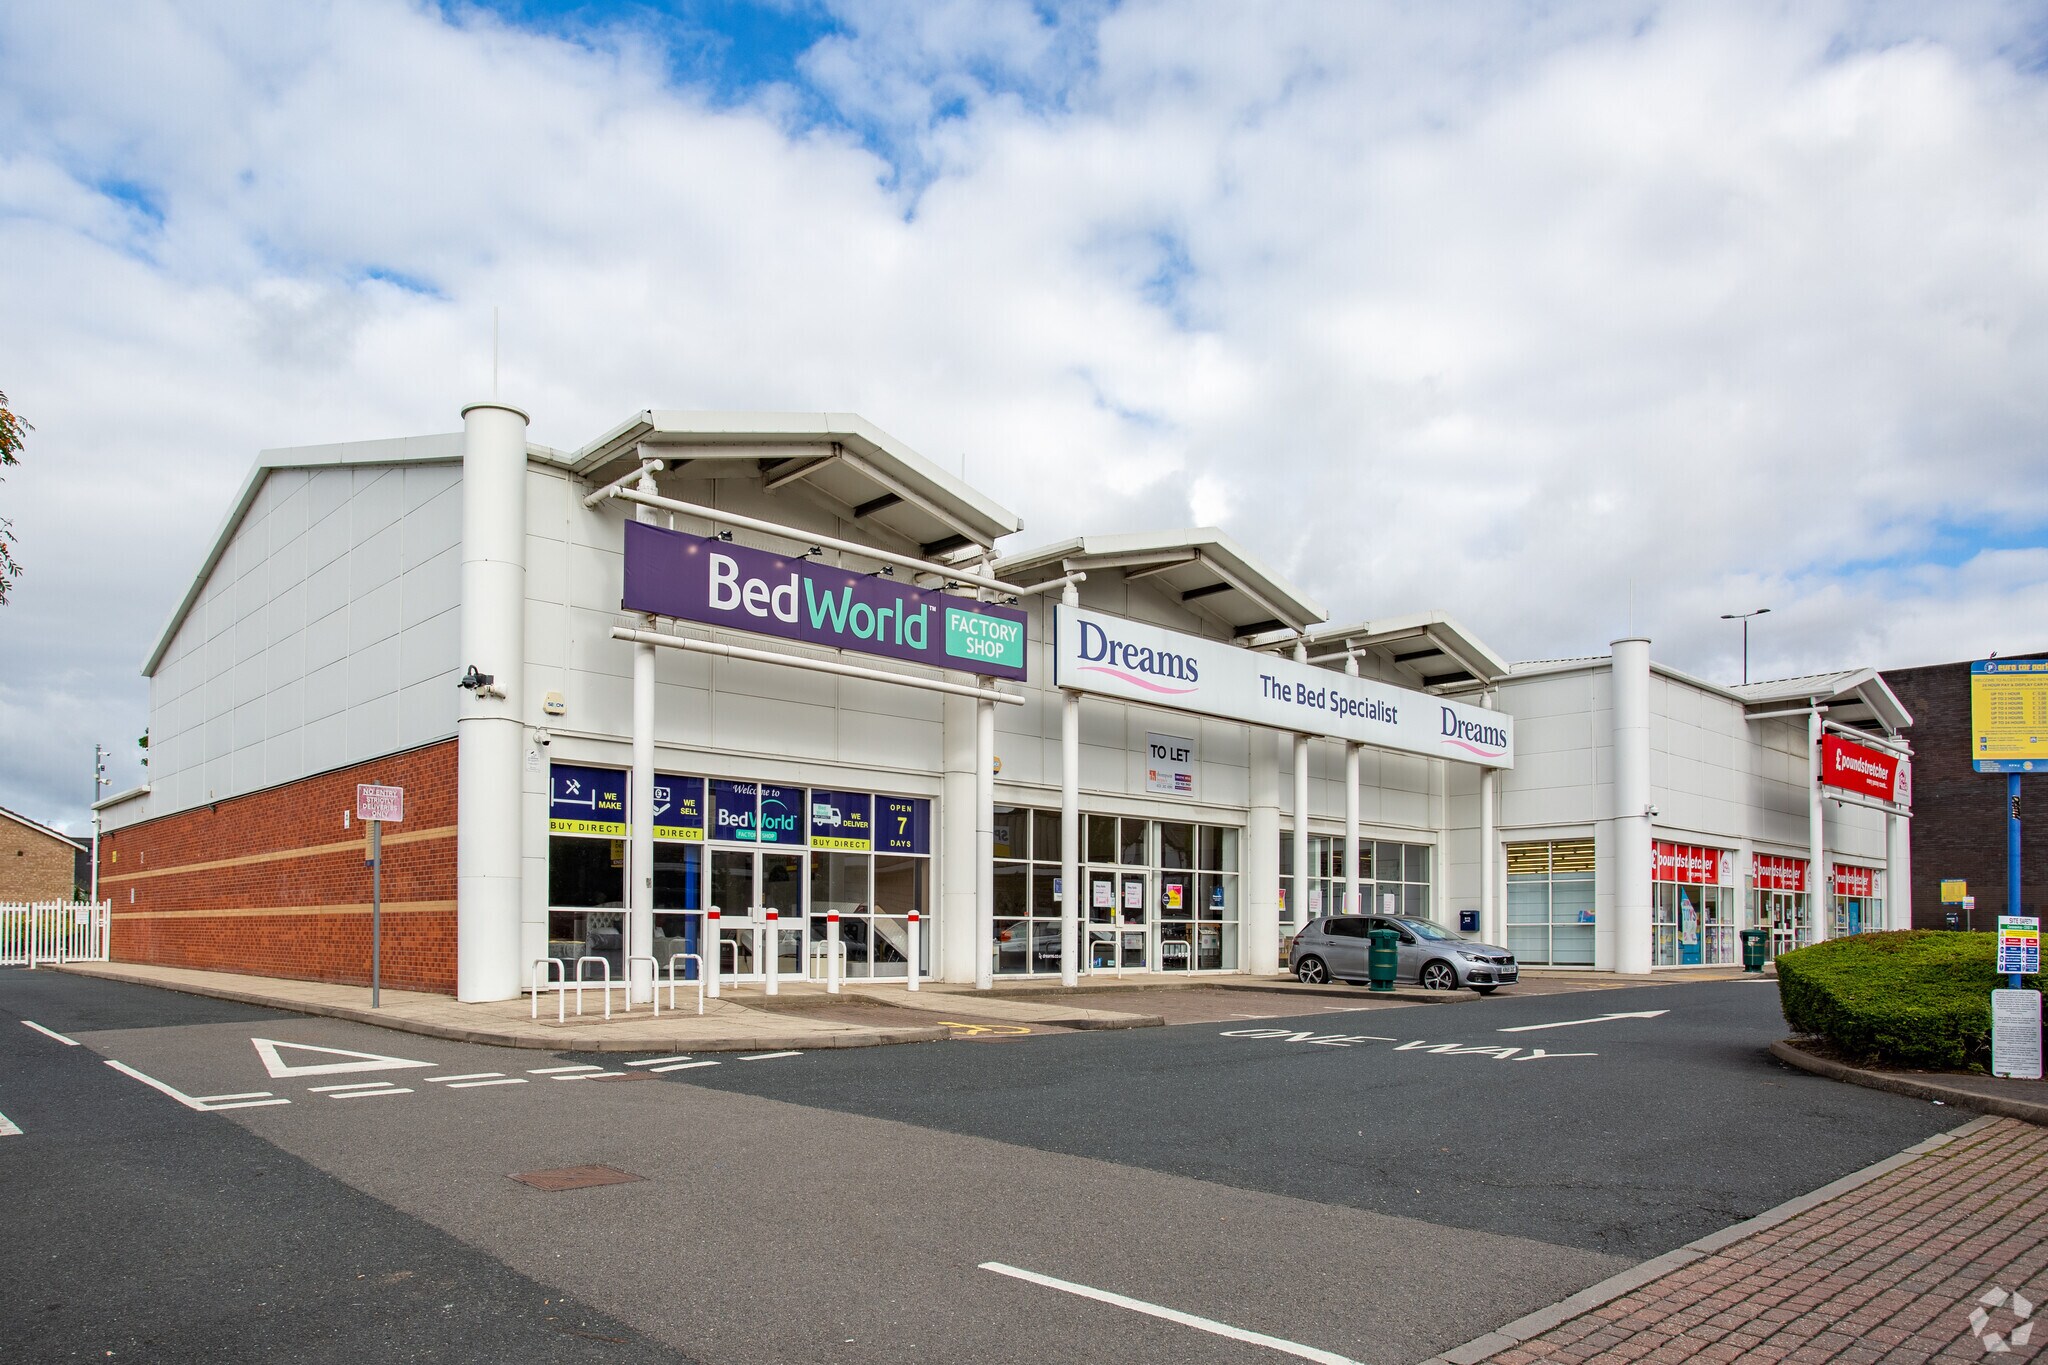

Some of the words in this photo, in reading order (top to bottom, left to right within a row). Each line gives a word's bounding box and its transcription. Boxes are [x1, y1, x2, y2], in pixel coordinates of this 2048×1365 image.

[951, 614, 1017, 643] FACTORY
[966, 638, 1005, 659] SHOP
[1077, 619, 1199, 683] Dreams
[1260, 675, 1292, 702] The
[1296, 683, 1326, 710] Bed
[1330, 691, 1398, 725] Specialist
[1441, 706, 1507, 749] Dreams
[1150, 744, 1166, 759] TO
[1170, 747, 1190, 762] LET
[604, 792, 617, 801] WE
[733, 785, 770, 796] Welcme
[598, 801, 621, 810] MAKE
[680, 807, 698, 815] SELL
[890, 804, 912, 812] OPEN
[579, 824, 619, 832] DIRECT
[660, 829, 698, 838] DIRECT
[897, 817, 907, 834] 7
[1220, 1029, 1397, 1046] ONE
[1393, 1040, 1598, 1060] WAY
